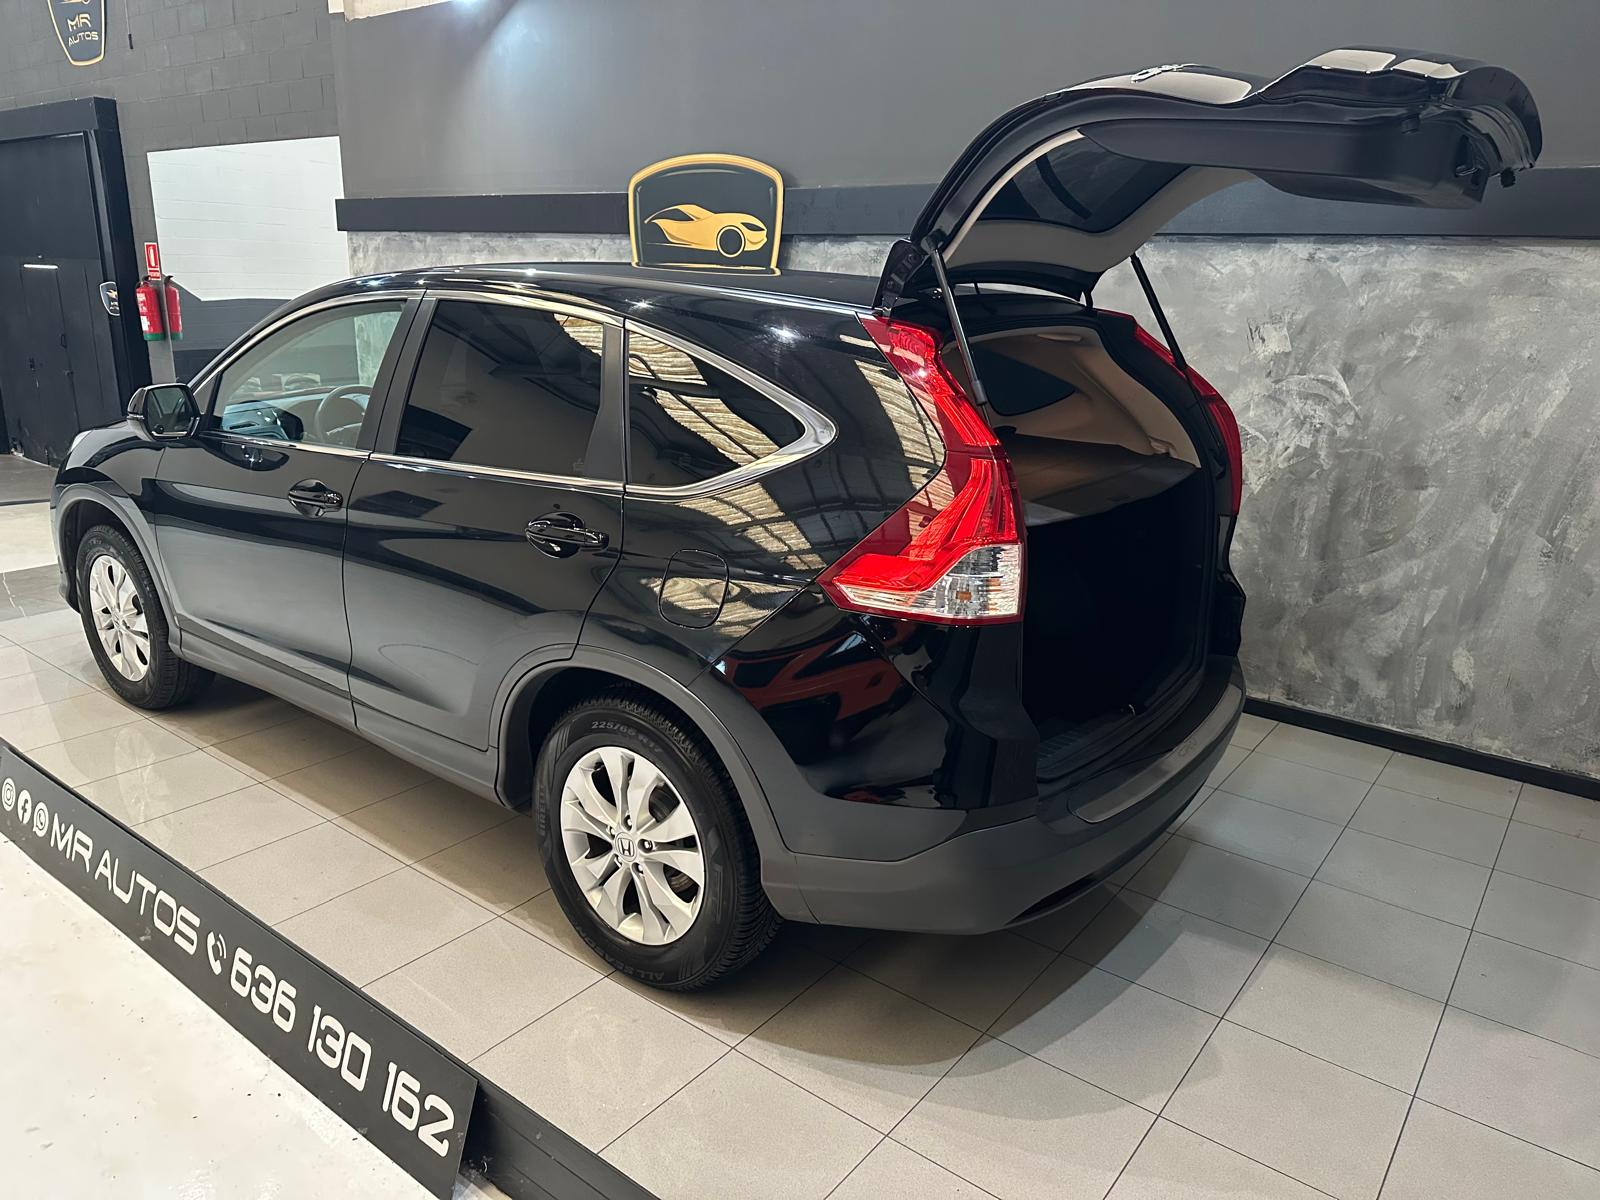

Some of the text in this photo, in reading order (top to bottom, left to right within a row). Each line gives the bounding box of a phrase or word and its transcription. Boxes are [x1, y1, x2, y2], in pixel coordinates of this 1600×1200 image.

[67, 13, 92, 32] MR
[68, 31, 99, 47] AUTOS
[50, 812, 455, 1158] MR AUTOS 636 130 162
